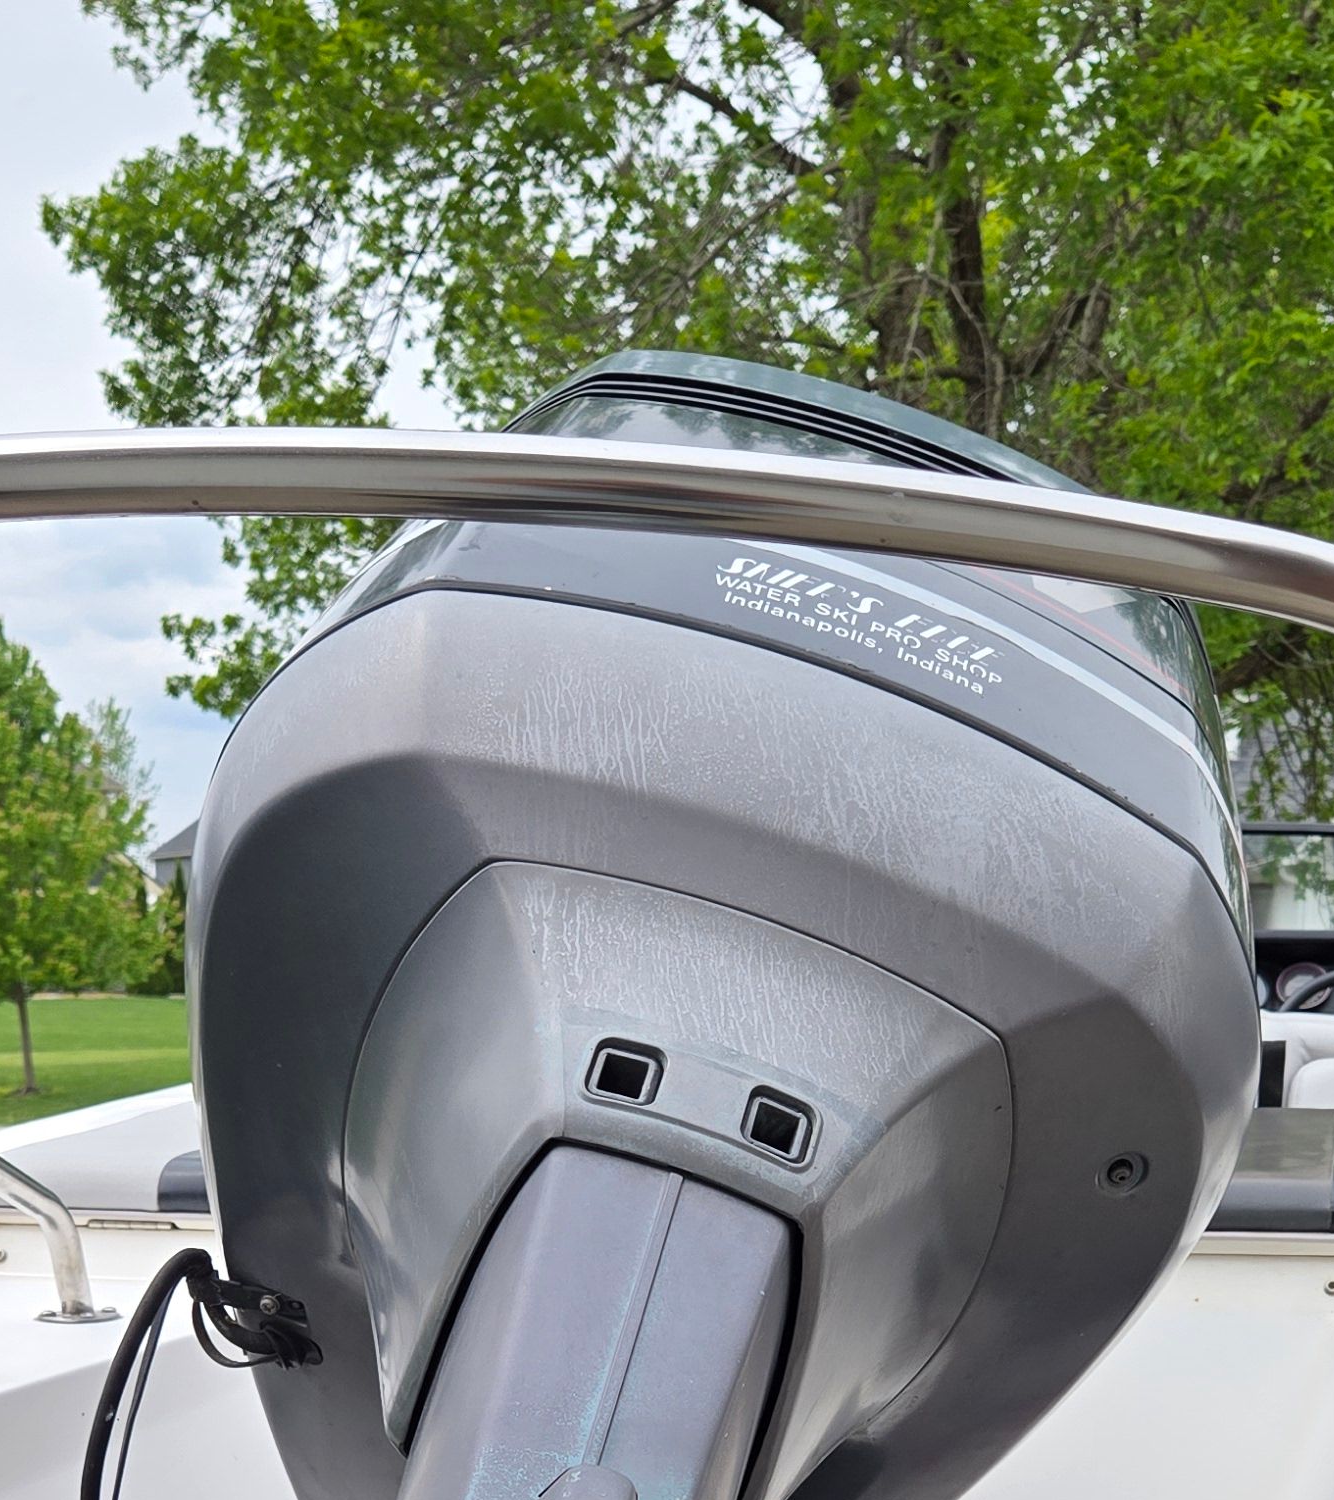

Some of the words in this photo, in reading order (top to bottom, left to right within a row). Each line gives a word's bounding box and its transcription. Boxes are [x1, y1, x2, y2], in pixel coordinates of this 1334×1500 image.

[715, 573, 801, 607] WATER
[814, 602, 858, 627] SKI
[870, 620, 922, 649] PRO
[934, 648, 1002, 685] SHOP
[724, 591, 883, 654] Indianapolis,
[896, 647, 984, 695] Indiana
